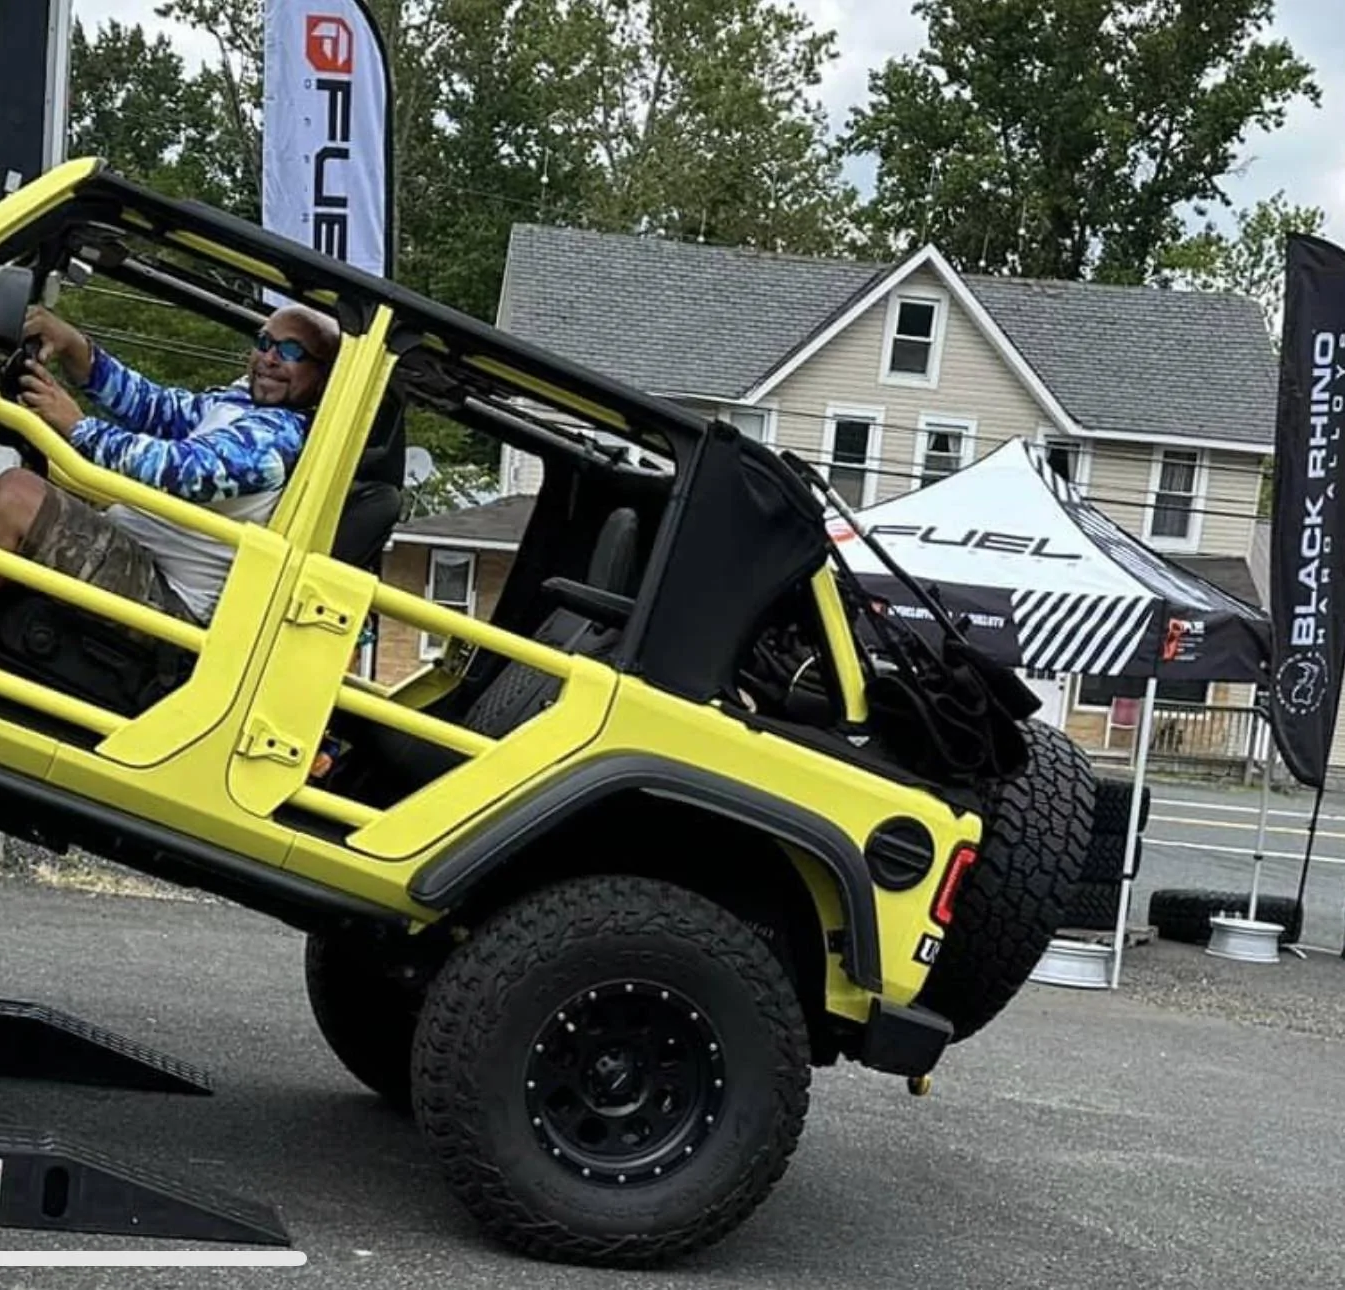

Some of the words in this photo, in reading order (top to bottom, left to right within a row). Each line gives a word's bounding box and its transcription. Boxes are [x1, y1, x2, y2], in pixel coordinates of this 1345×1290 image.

[313, 78, 353, 262] FUE
[1307, 332, 1335, 478] RHINO
[865, 525, 1083, 560] FUEL
[1291, 494, 1324, 646] BLACK
